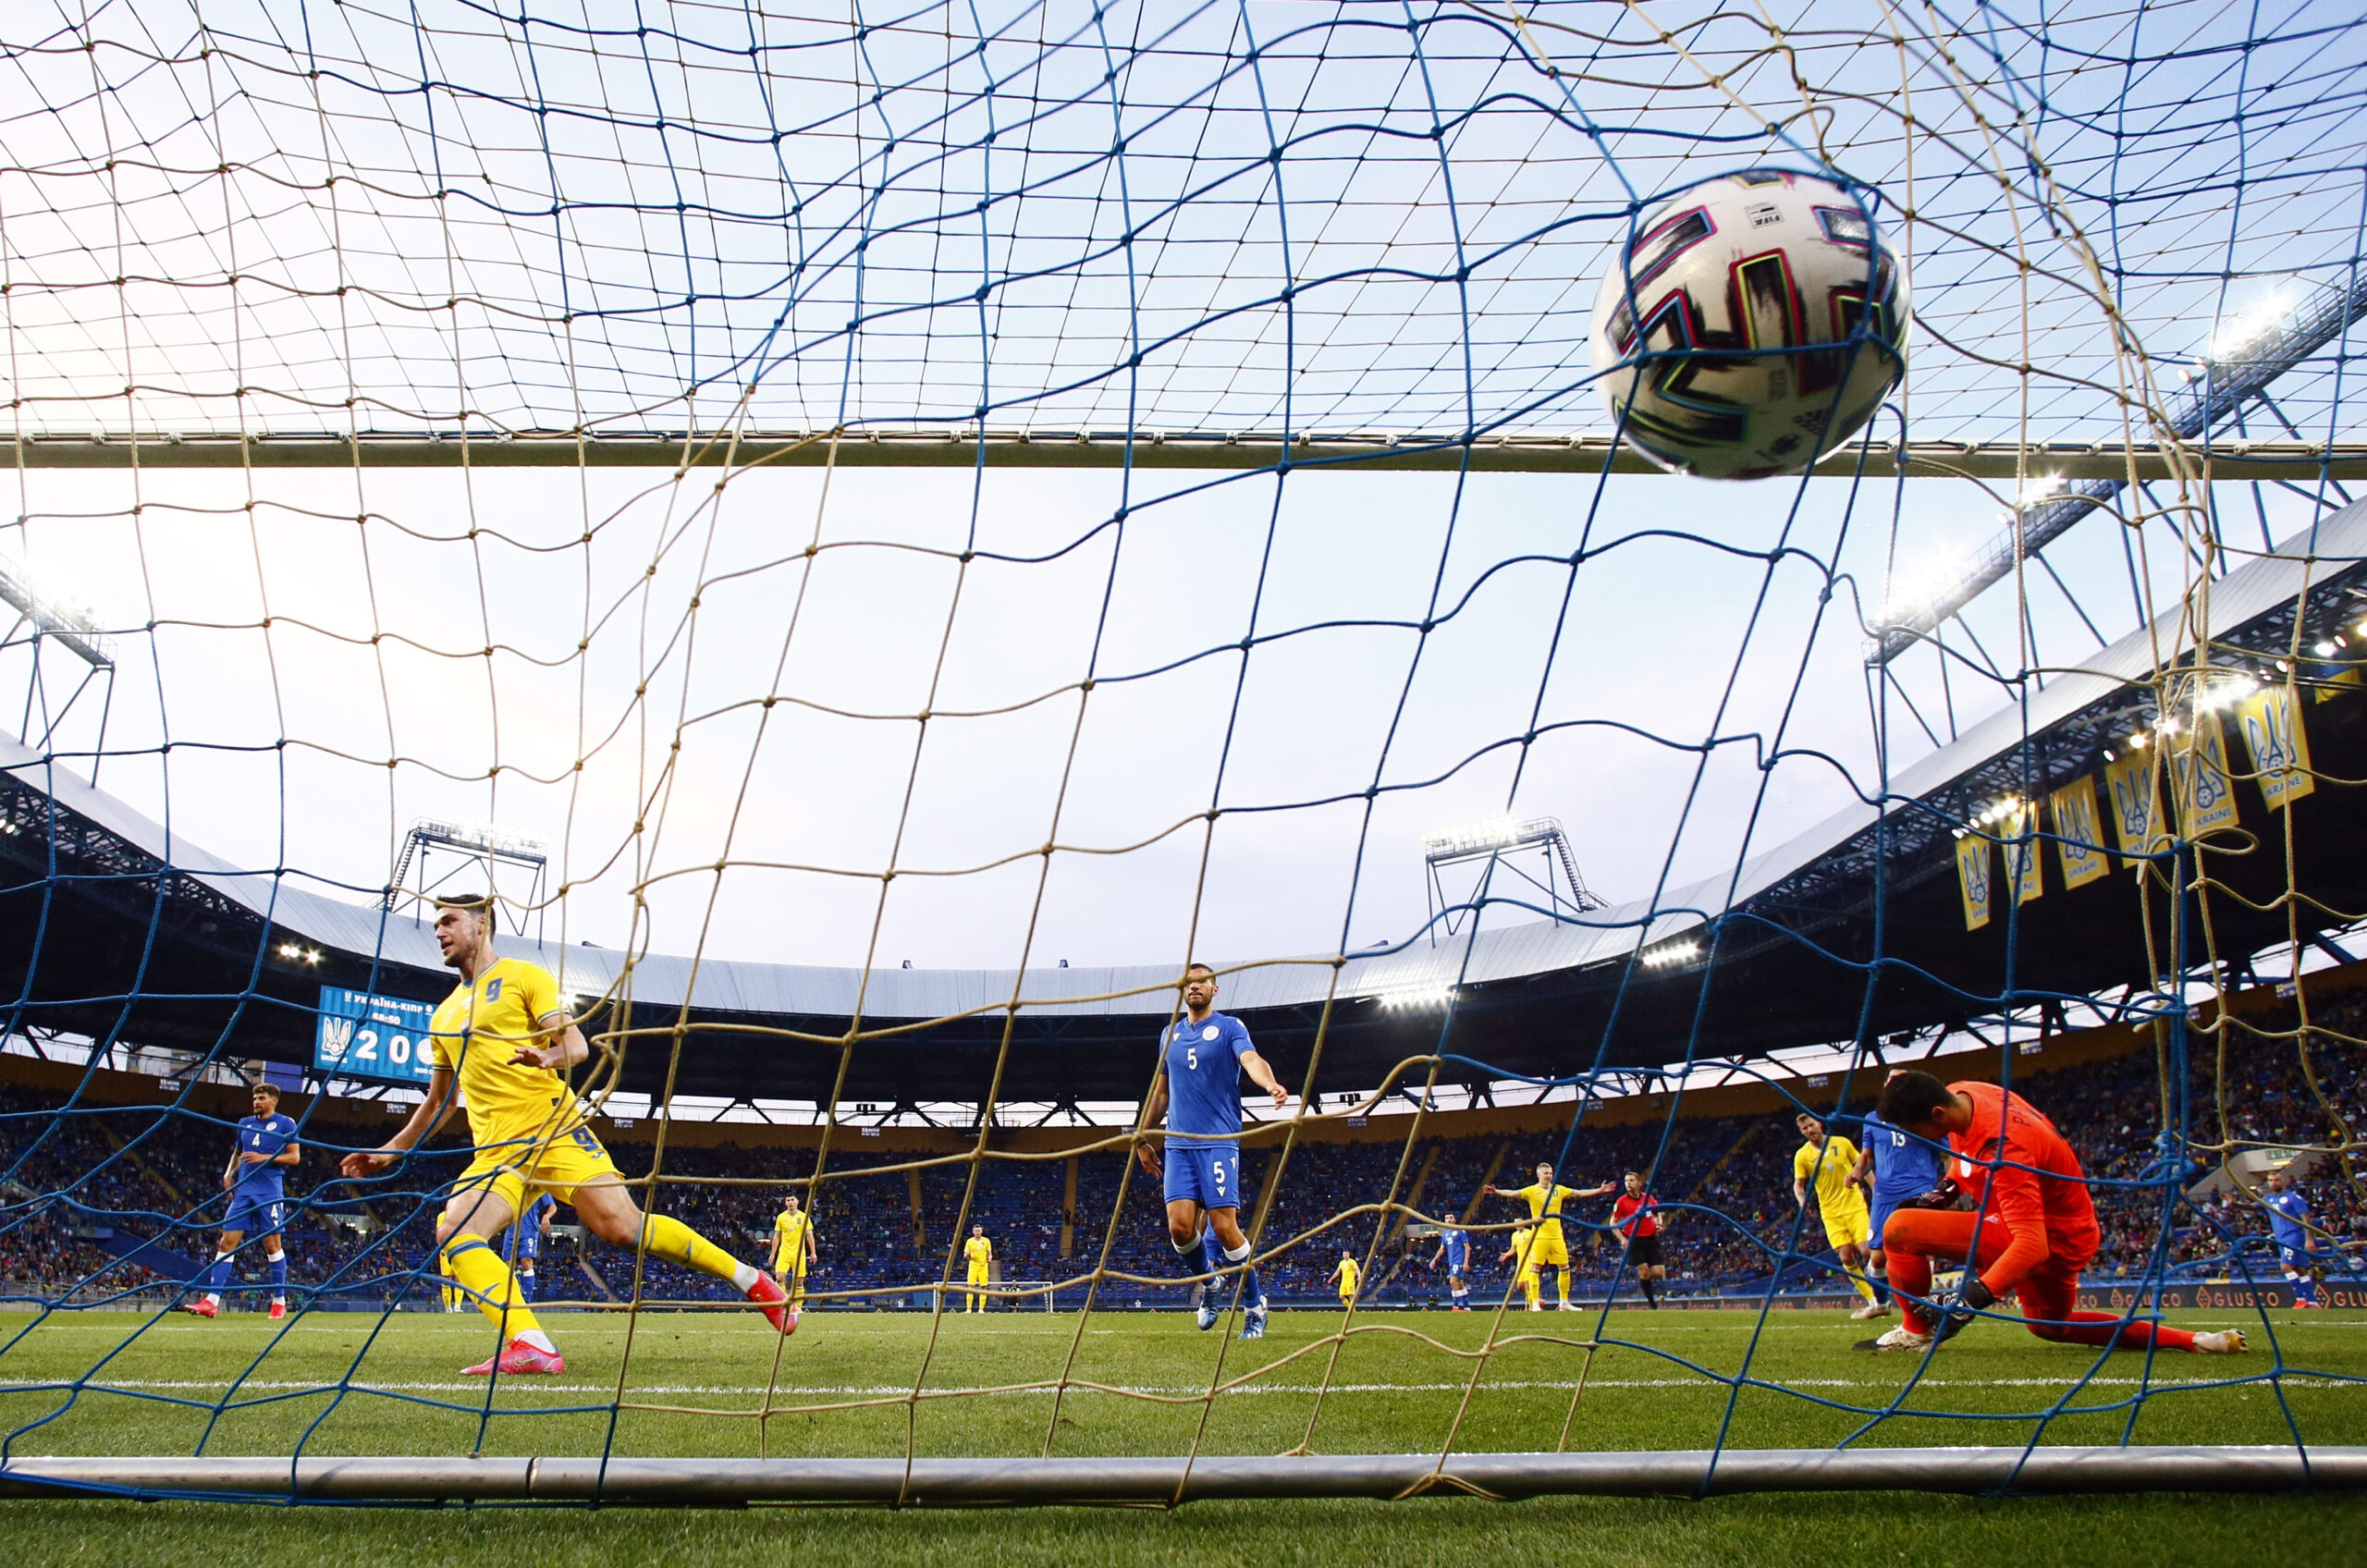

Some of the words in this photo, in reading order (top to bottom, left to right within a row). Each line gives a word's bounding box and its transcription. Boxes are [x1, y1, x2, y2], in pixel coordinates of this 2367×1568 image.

[485, 977, 503, 1003] 9
[355, 1030, 378, 1060] 2
[389, 1035, 411, 1064] 0
[1187, 1047, 1198, 1071] 5
[251, 1133, 261, 1147] 4
[571, 1127, 599, 1152] 9
[1890, 1130, 1906, 1147] 13
[1831, 1145, 1838, 1158] 7
[1213, 1160, 1226, 1184] 5
[271, 1204, 279, 1219] 4
[2126, 1293, 2184, 1308] GUCO
